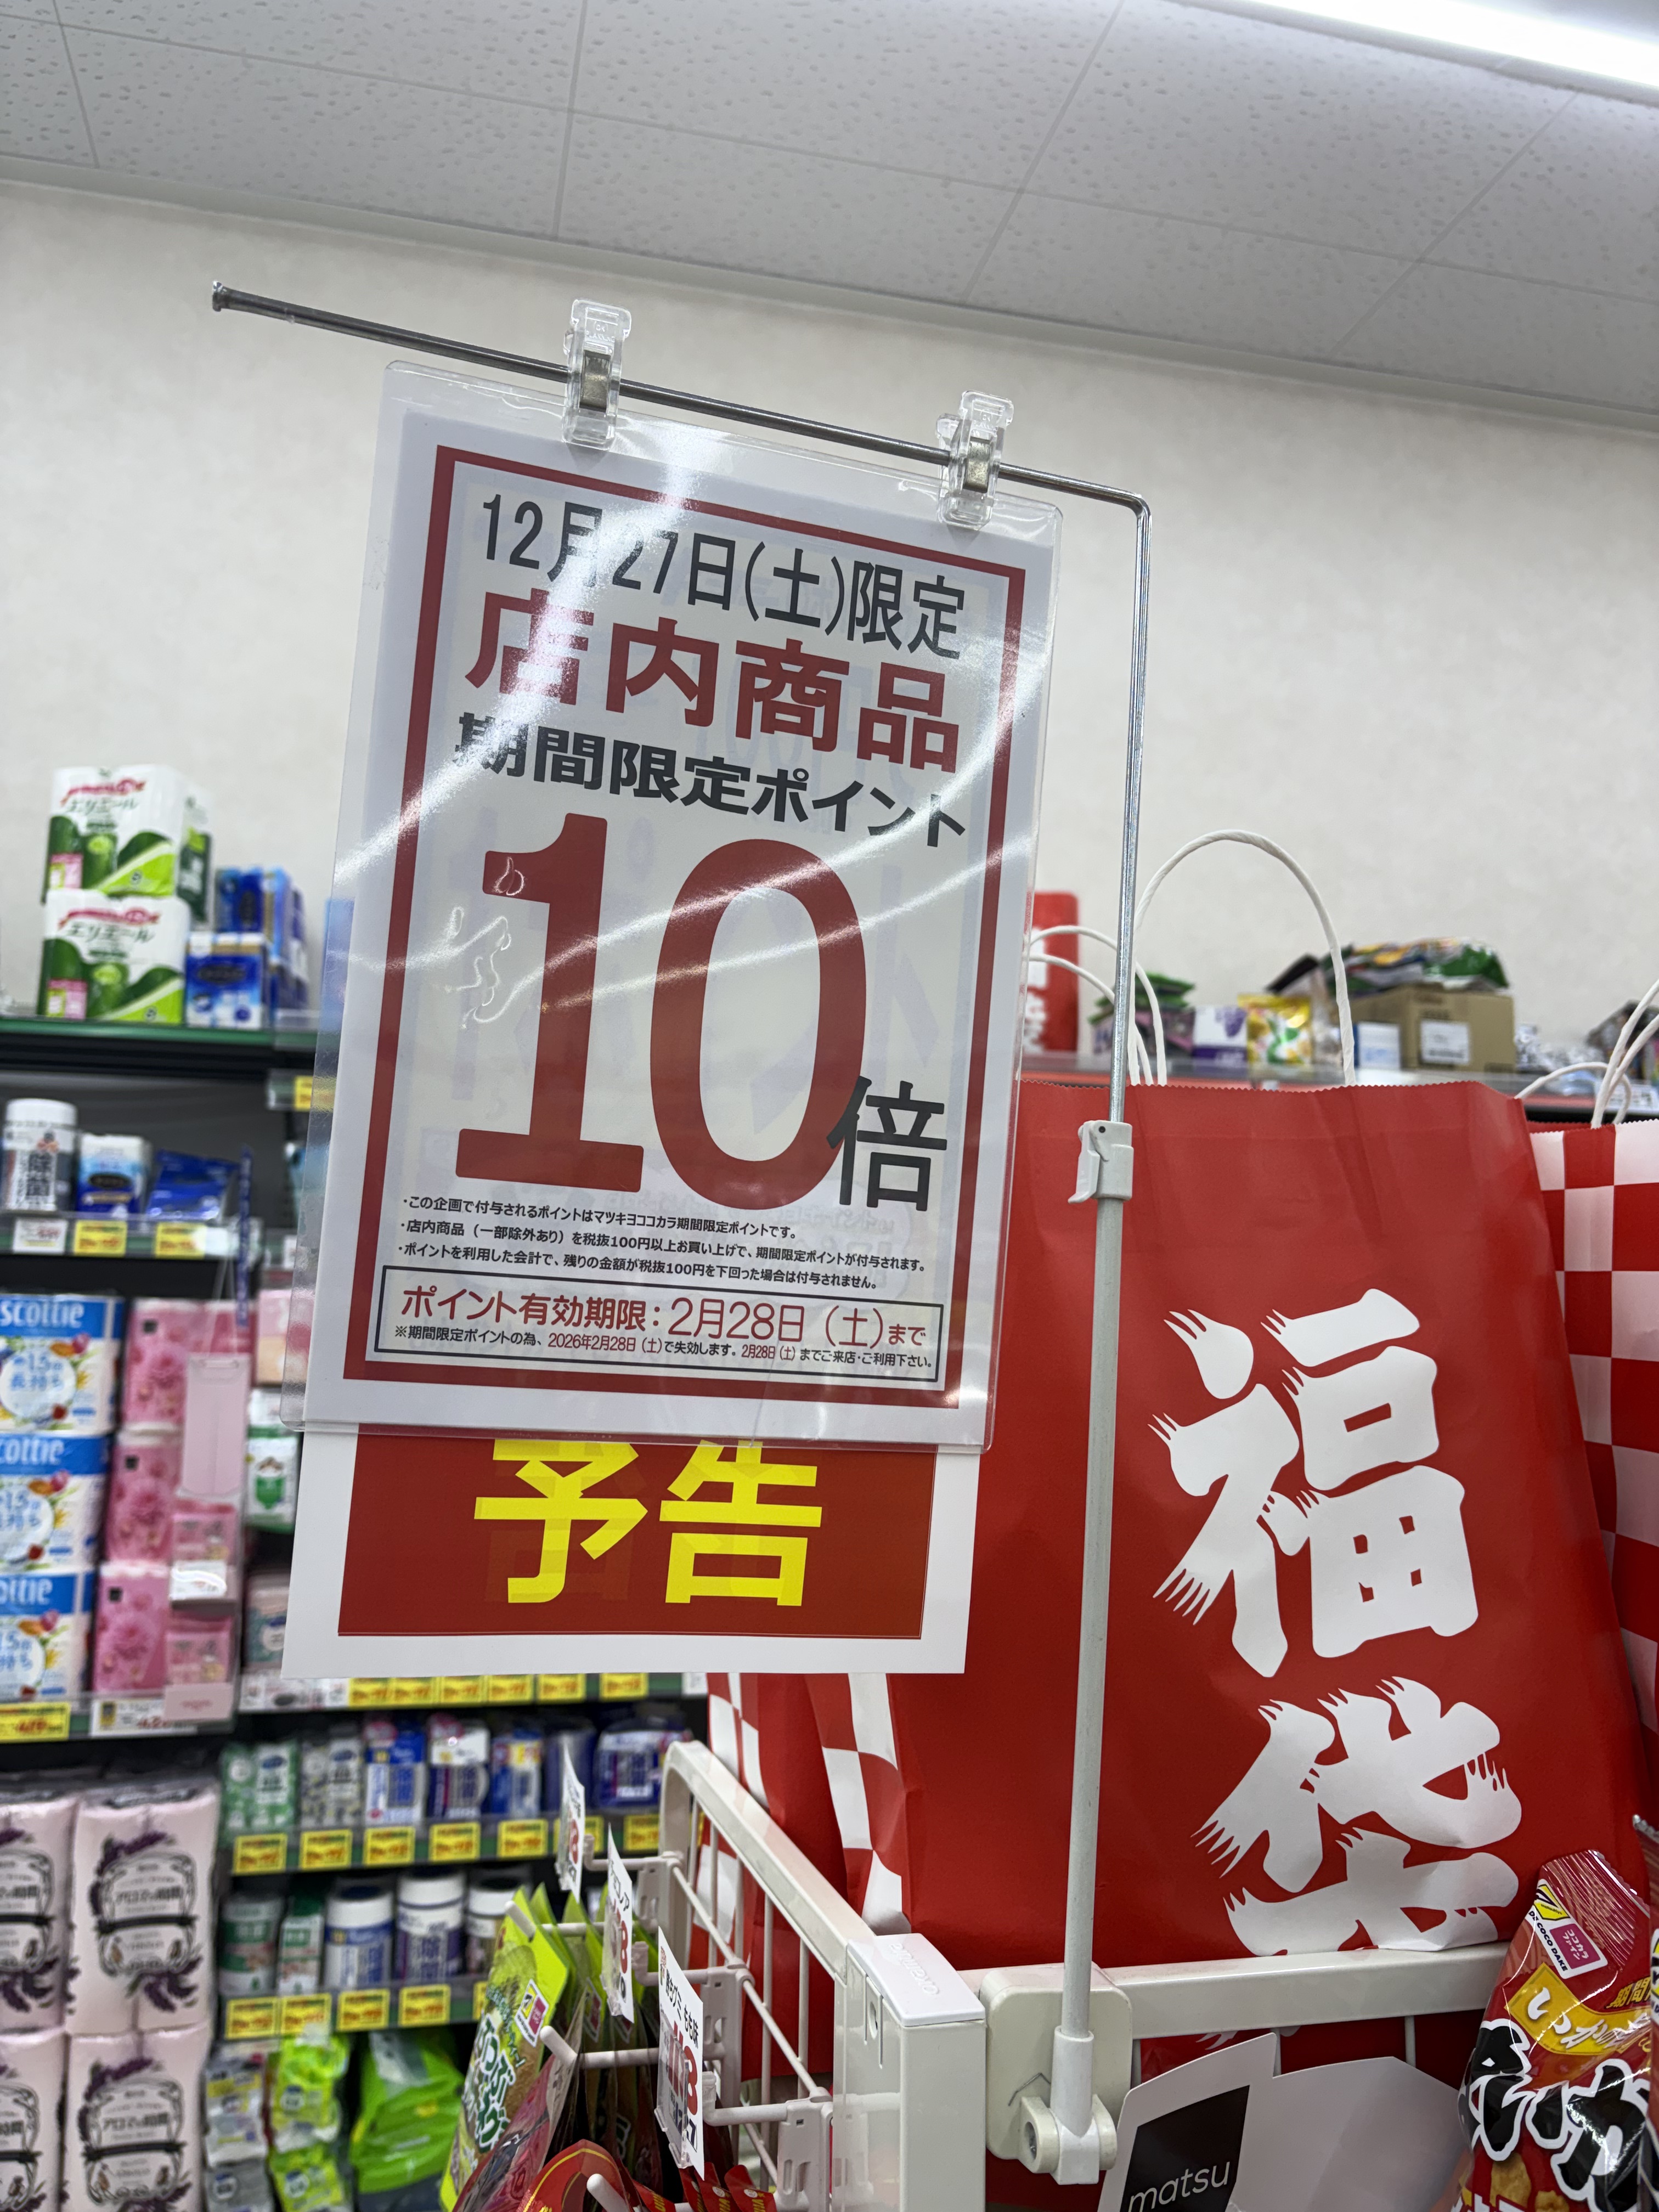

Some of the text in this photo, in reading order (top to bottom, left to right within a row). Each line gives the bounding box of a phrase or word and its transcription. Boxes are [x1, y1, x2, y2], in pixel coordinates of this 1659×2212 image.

[465, 588, 961, 773] 店内商品
[452, 711, 966, 848] 期間限定ポイント
[474, 1437, 822, 1607] 予告
[1537, 1922, 1553, 1946] COCO
[1551, 1947, 1568, 1972] DAKE
[1128, 2160, 1231, 2212] matsu
